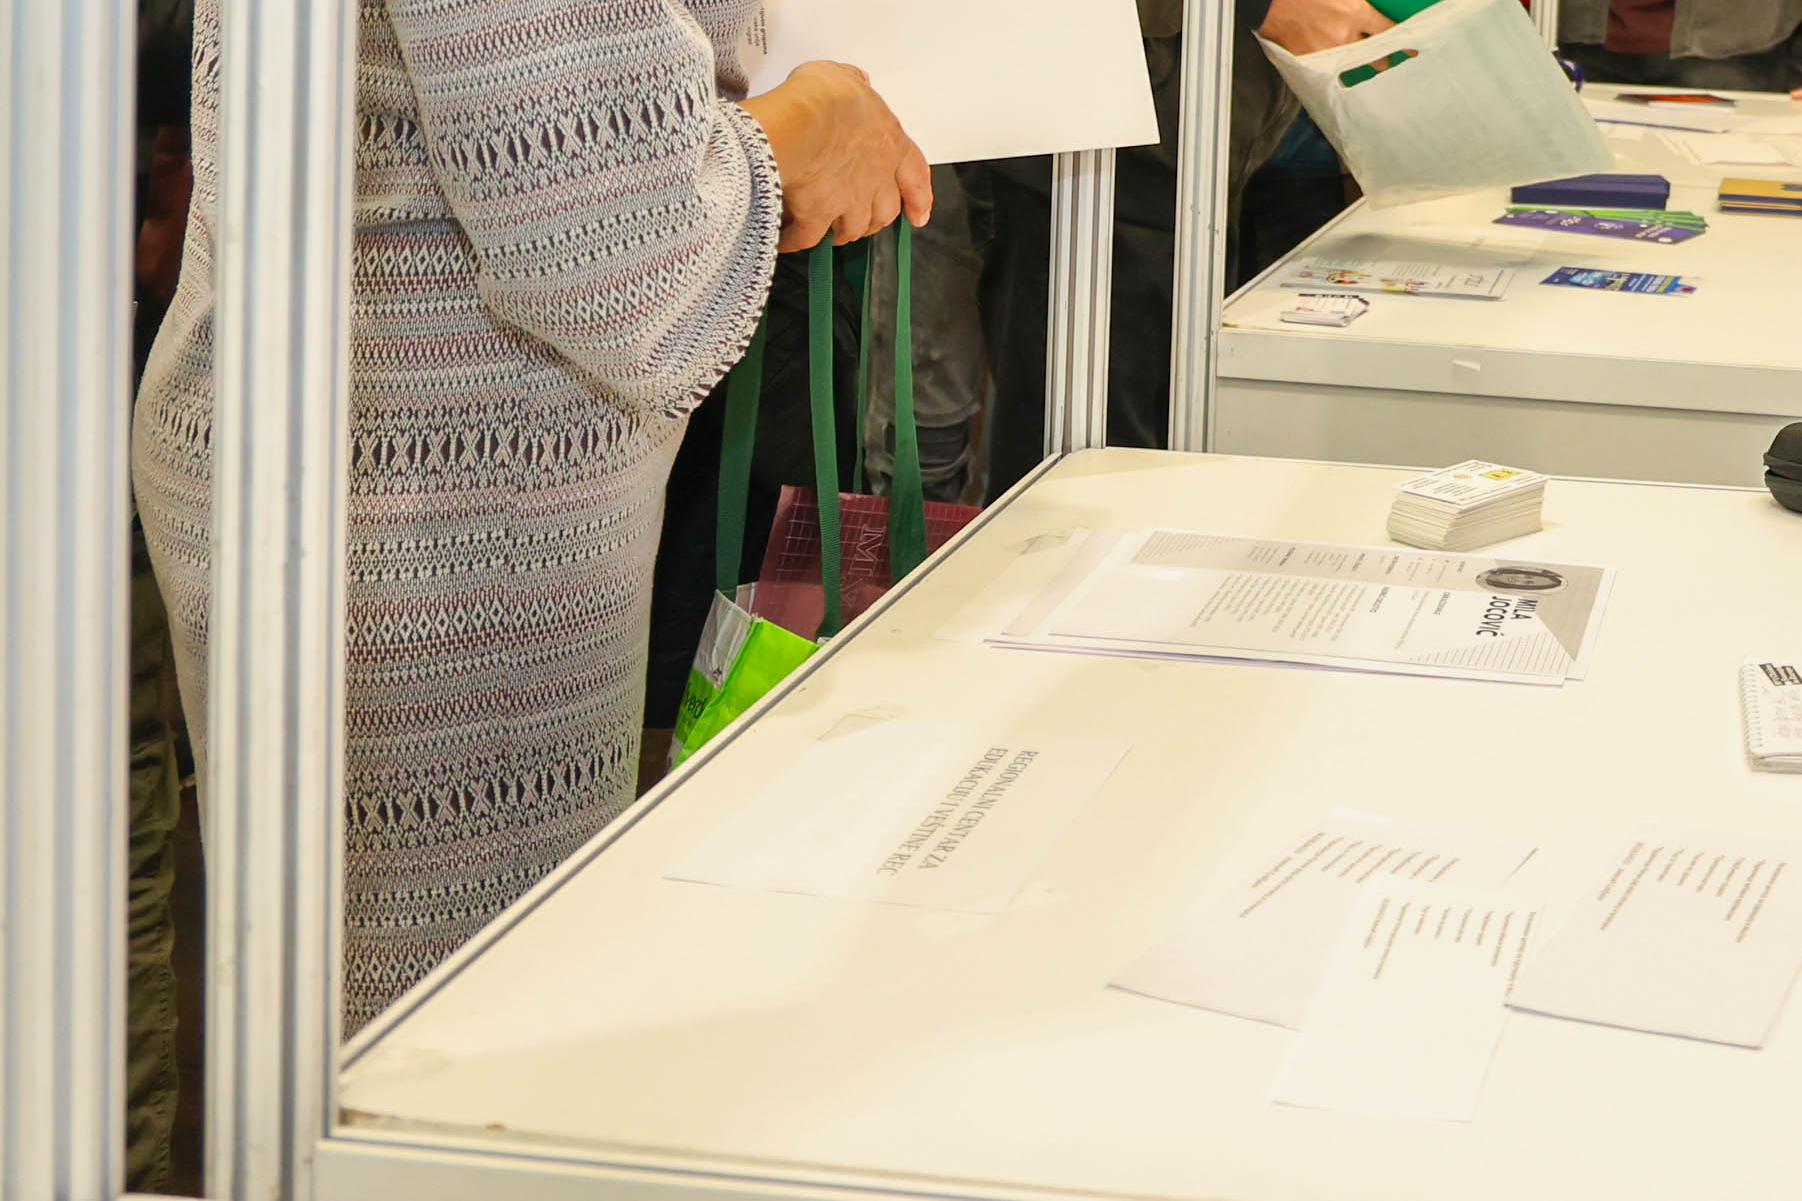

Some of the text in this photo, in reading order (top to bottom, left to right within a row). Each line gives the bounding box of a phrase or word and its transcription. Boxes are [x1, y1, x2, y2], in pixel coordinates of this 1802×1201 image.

[1475, 596, 1512, 637] JOCOVIĆ
[1510, 598, 1538, 620] MILA
[897, 807, 956, 853] VEŠTINE
[917, 749, 1041, 871] REGIONALNI CENTAR ZA
